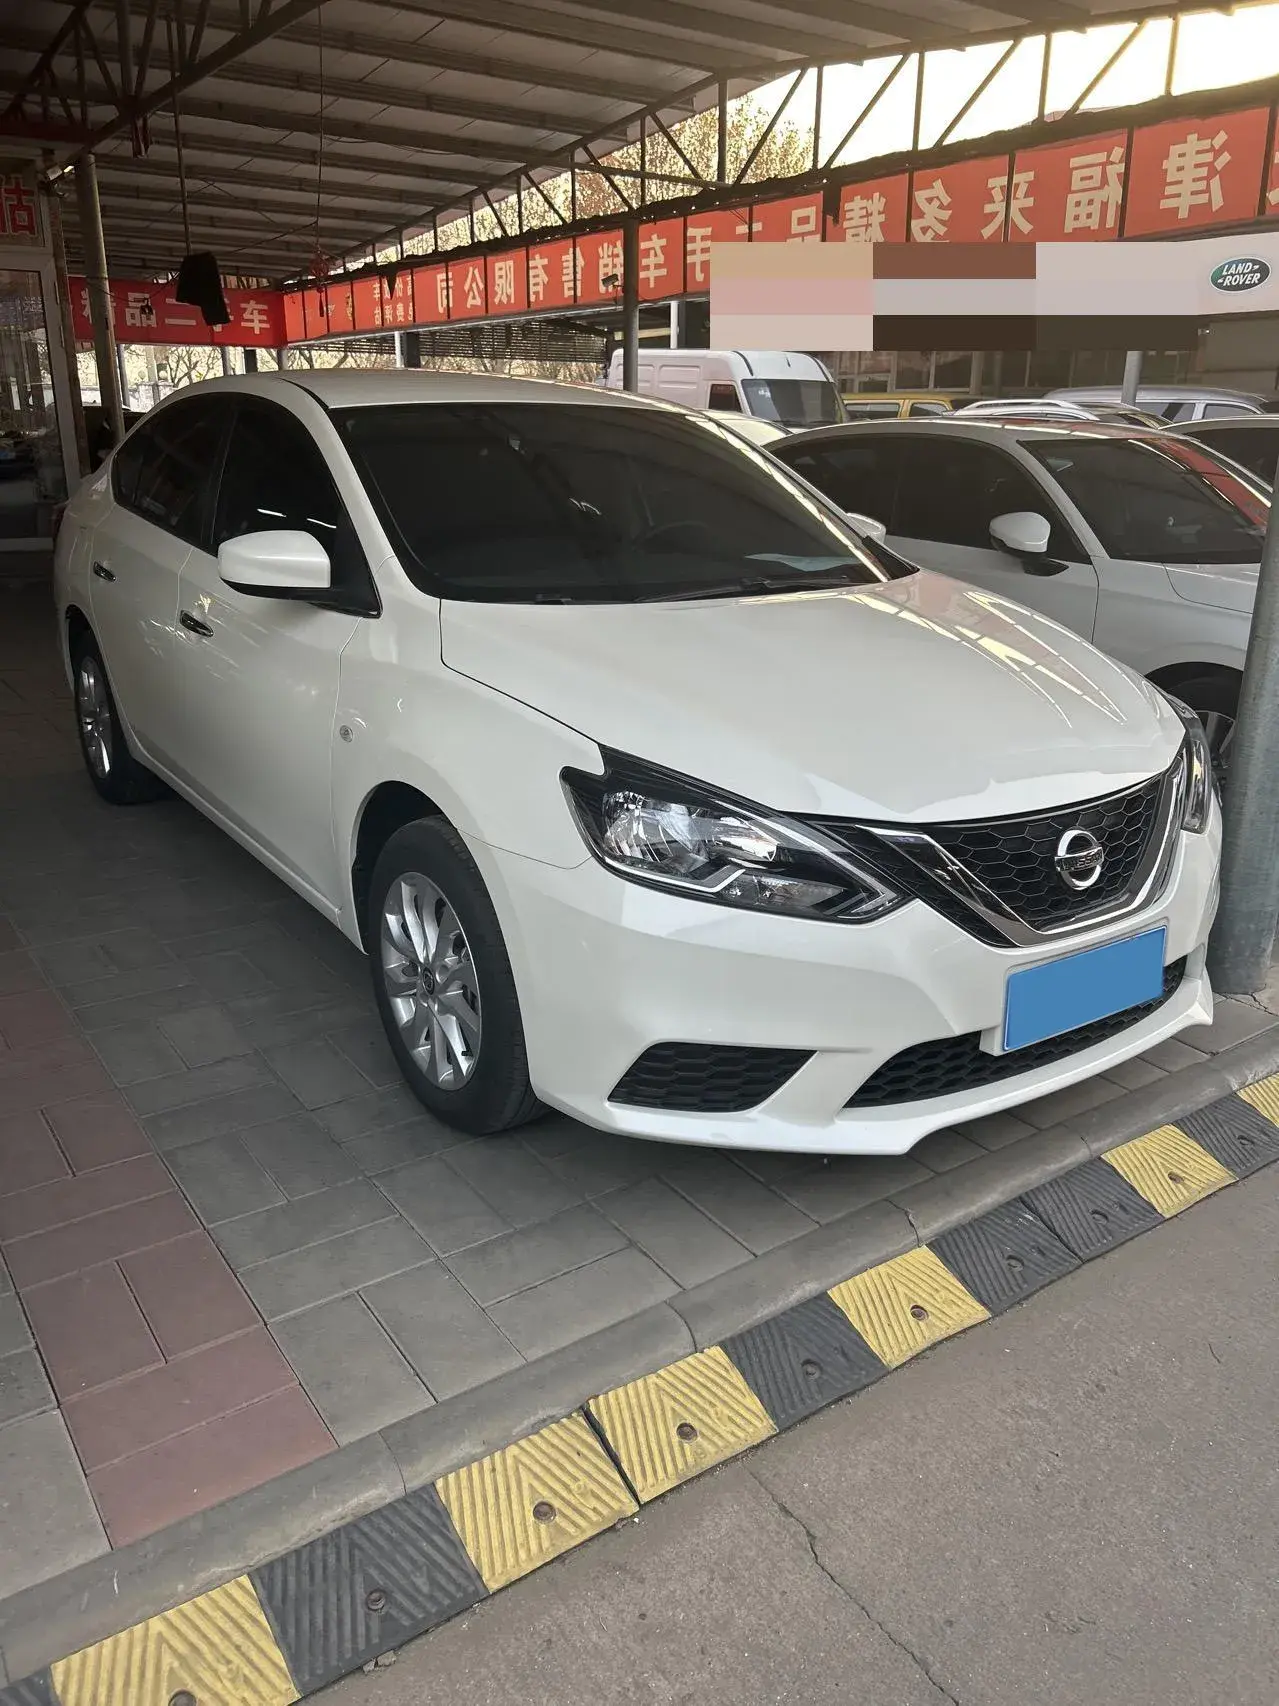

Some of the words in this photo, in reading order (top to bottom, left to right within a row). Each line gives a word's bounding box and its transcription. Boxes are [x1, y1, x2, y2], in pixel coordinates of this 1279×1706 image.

[1222, 262, 1253, 276] LAND
[1223, 273, 1261, 286] ROVER
[80, 287, 270, 335] 品二车
